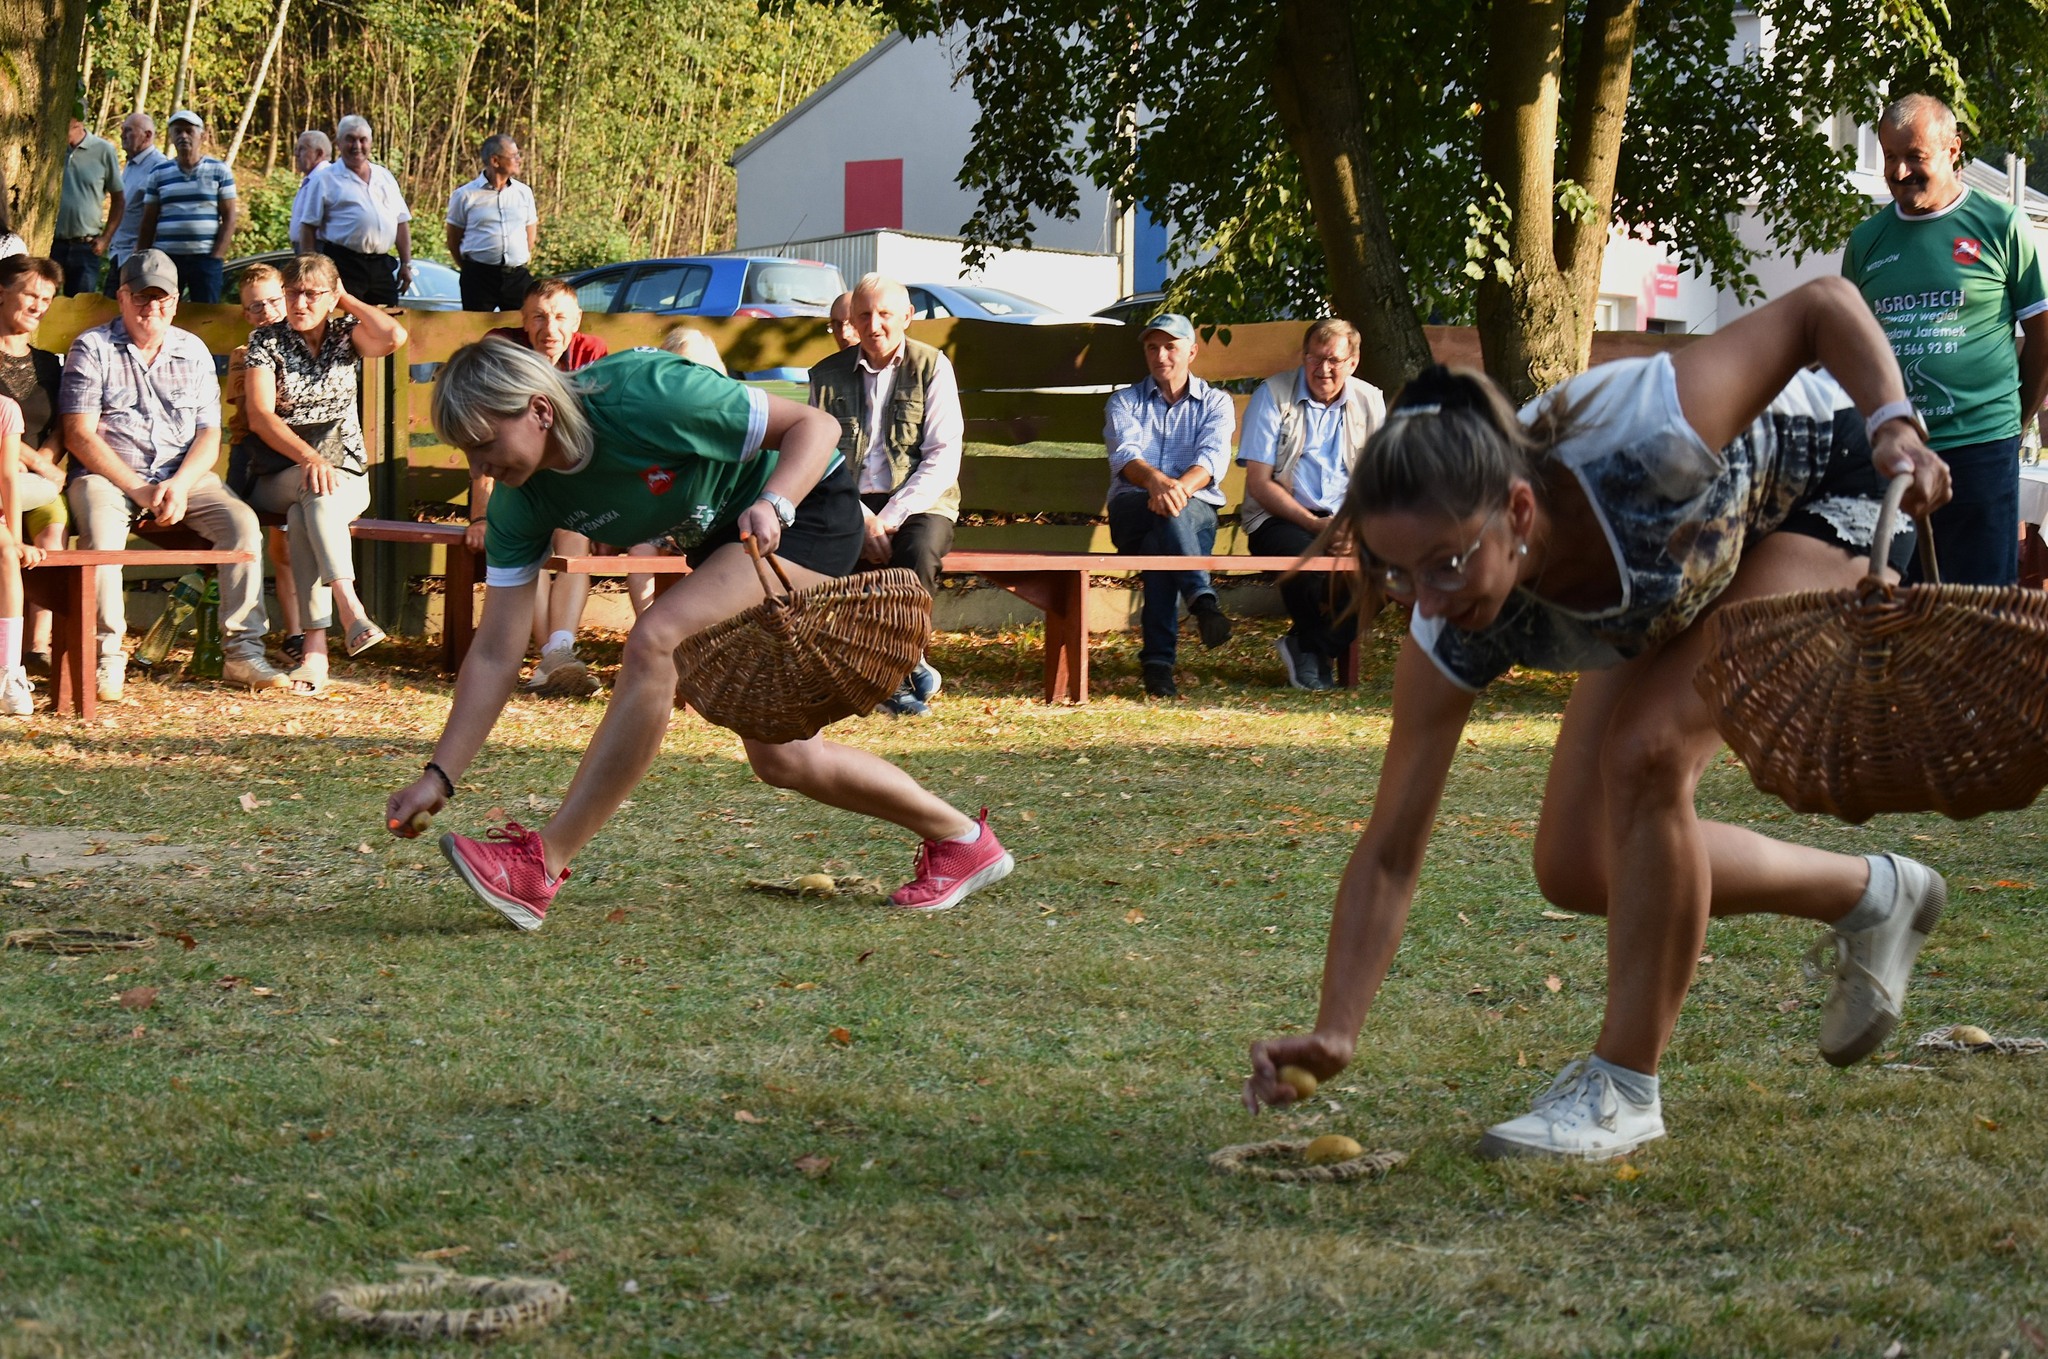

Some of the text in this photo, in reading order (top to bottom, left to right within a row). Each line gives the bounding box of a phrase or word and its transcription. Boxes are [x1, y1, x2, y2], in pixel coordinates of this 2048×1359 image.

[1874, 289, 1966, 315] AGRO-TECH
[1914, 325, 1967, 338] Jaremek
[1903, 343, 1924, 356] 566
[1927, 341, 1943, 354] 92
[1944, 341, 1958, 354] 81
